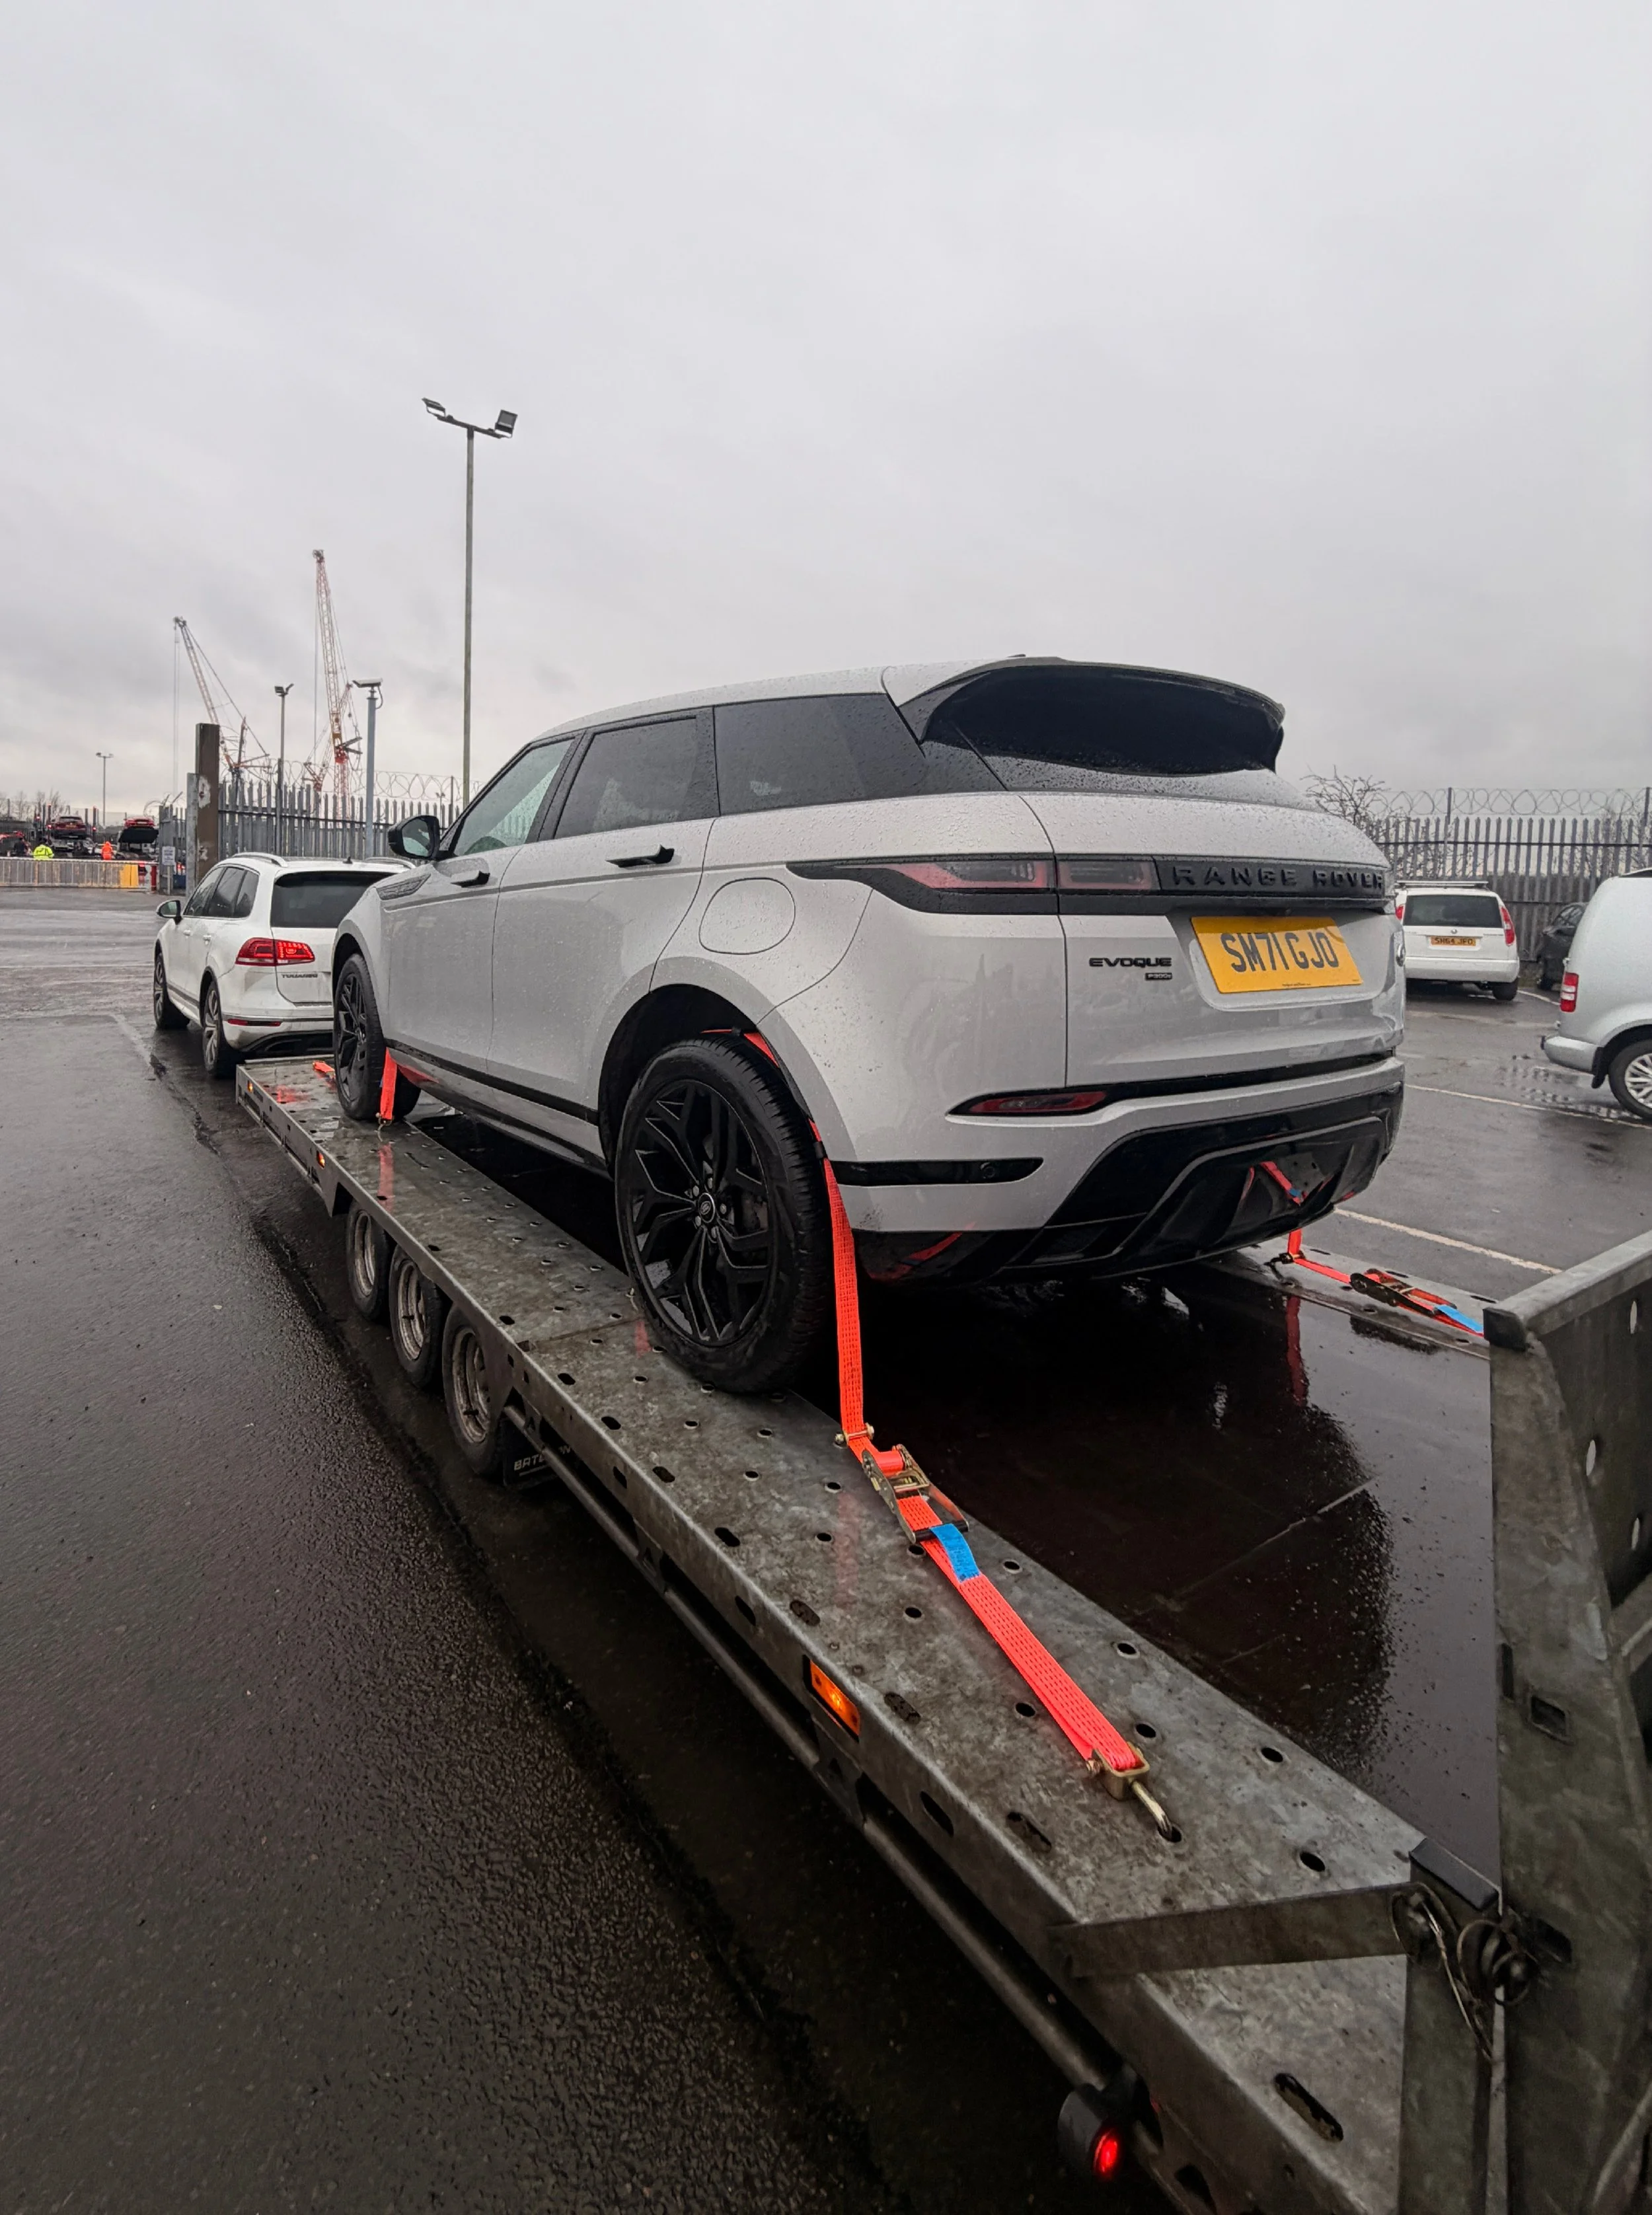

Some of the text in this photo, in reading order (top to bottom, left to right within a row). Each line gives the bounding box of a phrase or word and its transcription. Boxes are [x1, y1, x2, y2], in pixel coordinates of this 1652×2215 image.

[1173, 866, 1382, 889] RANGE ROVER
[1089, 957, 1172, 968] EVOQUE
